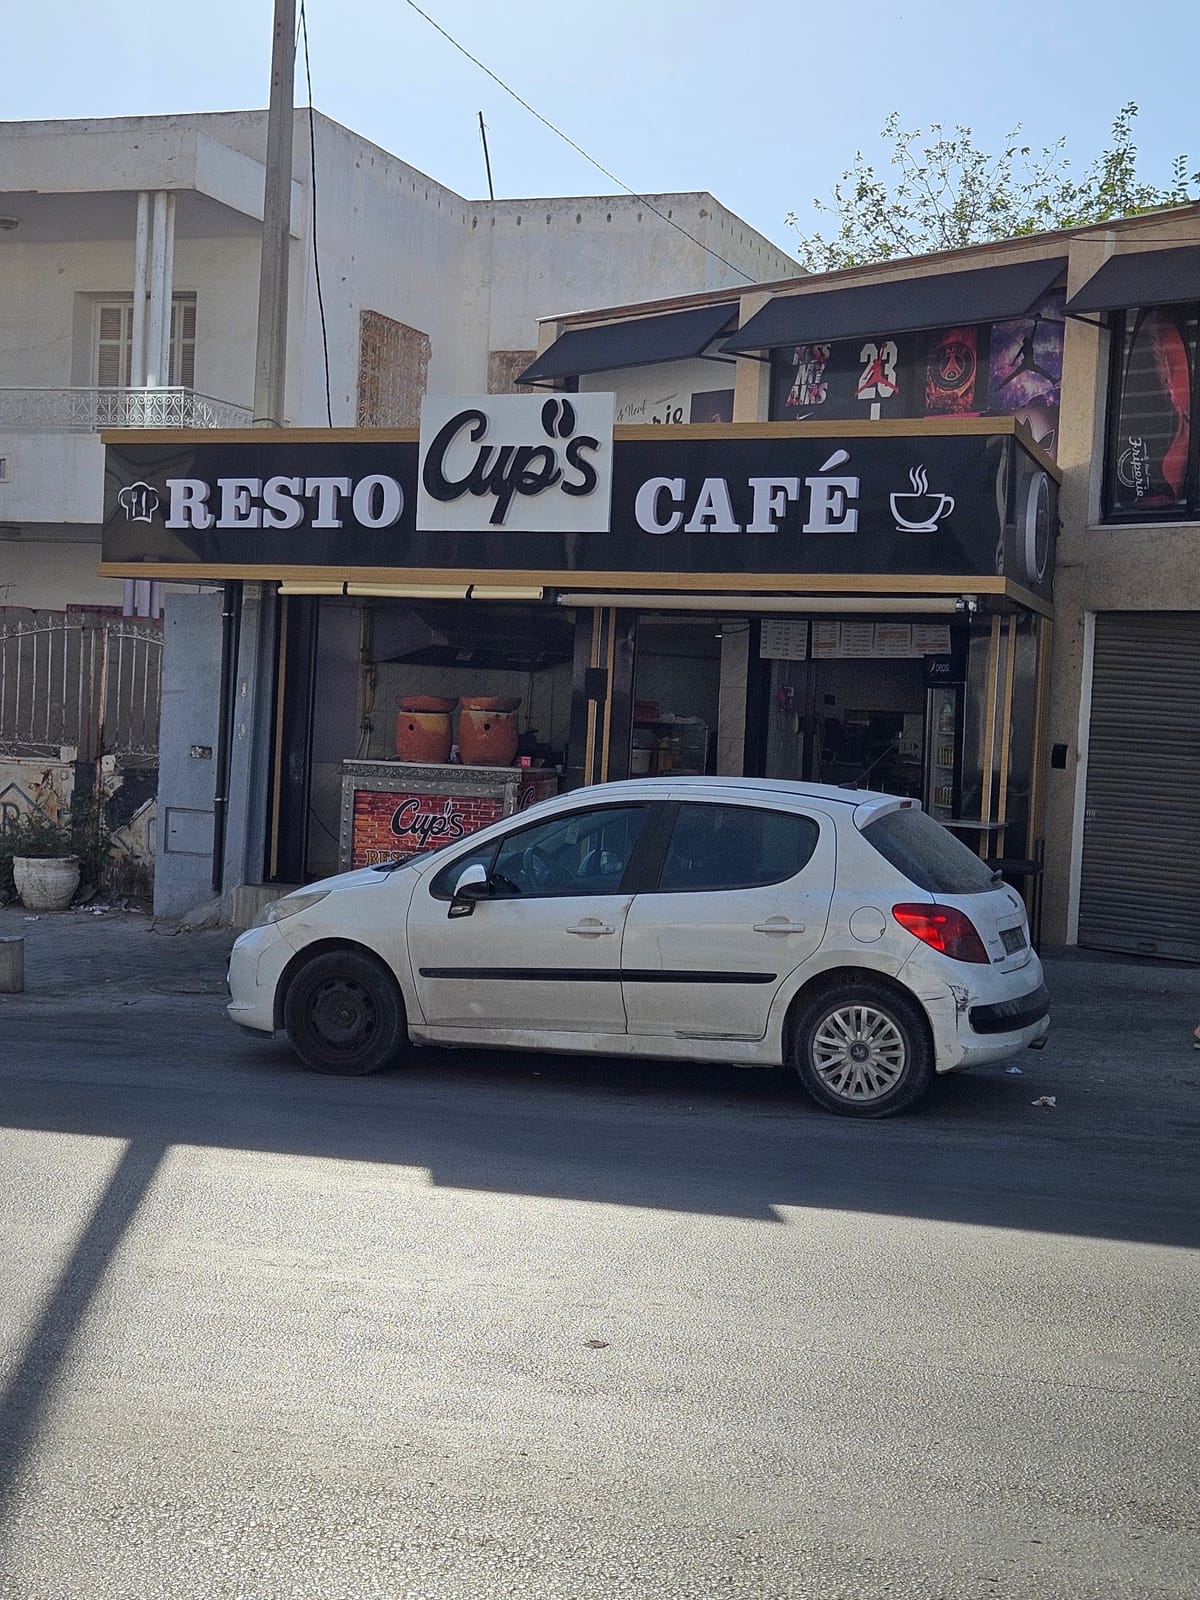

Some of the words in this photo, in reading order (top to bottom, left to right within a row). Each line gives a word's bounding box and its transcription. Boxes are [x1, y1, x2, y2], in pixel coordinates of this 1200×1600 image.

[856, 341, 898, 400] 23
[423, 398, 602, 525] Cup's
[634, 449, 860, 534] CAFÉ
[1128, 436, 1146, 497] Friperie
[165, 474, 405, 530] RESTO
[391, 798, 464, 848] Cup's
